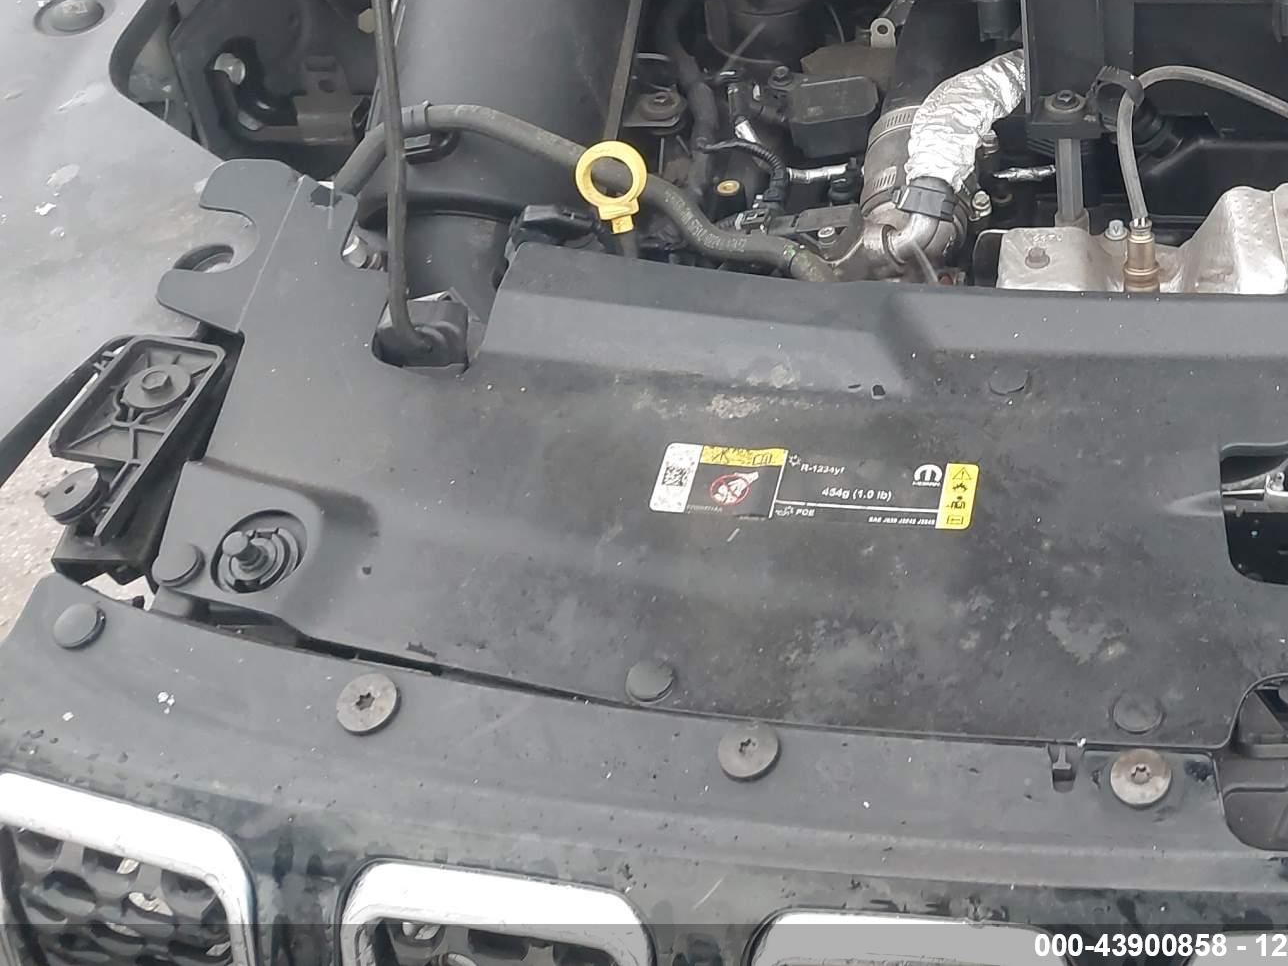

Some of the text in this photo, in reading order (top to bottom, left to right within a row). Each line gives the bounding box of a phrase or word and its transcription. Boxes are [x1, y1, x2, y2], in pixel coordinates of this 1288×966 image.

[800, 464, 845, 476] R-1234yf
[821, 487, 893, 502] 454g (1.0 lb)
